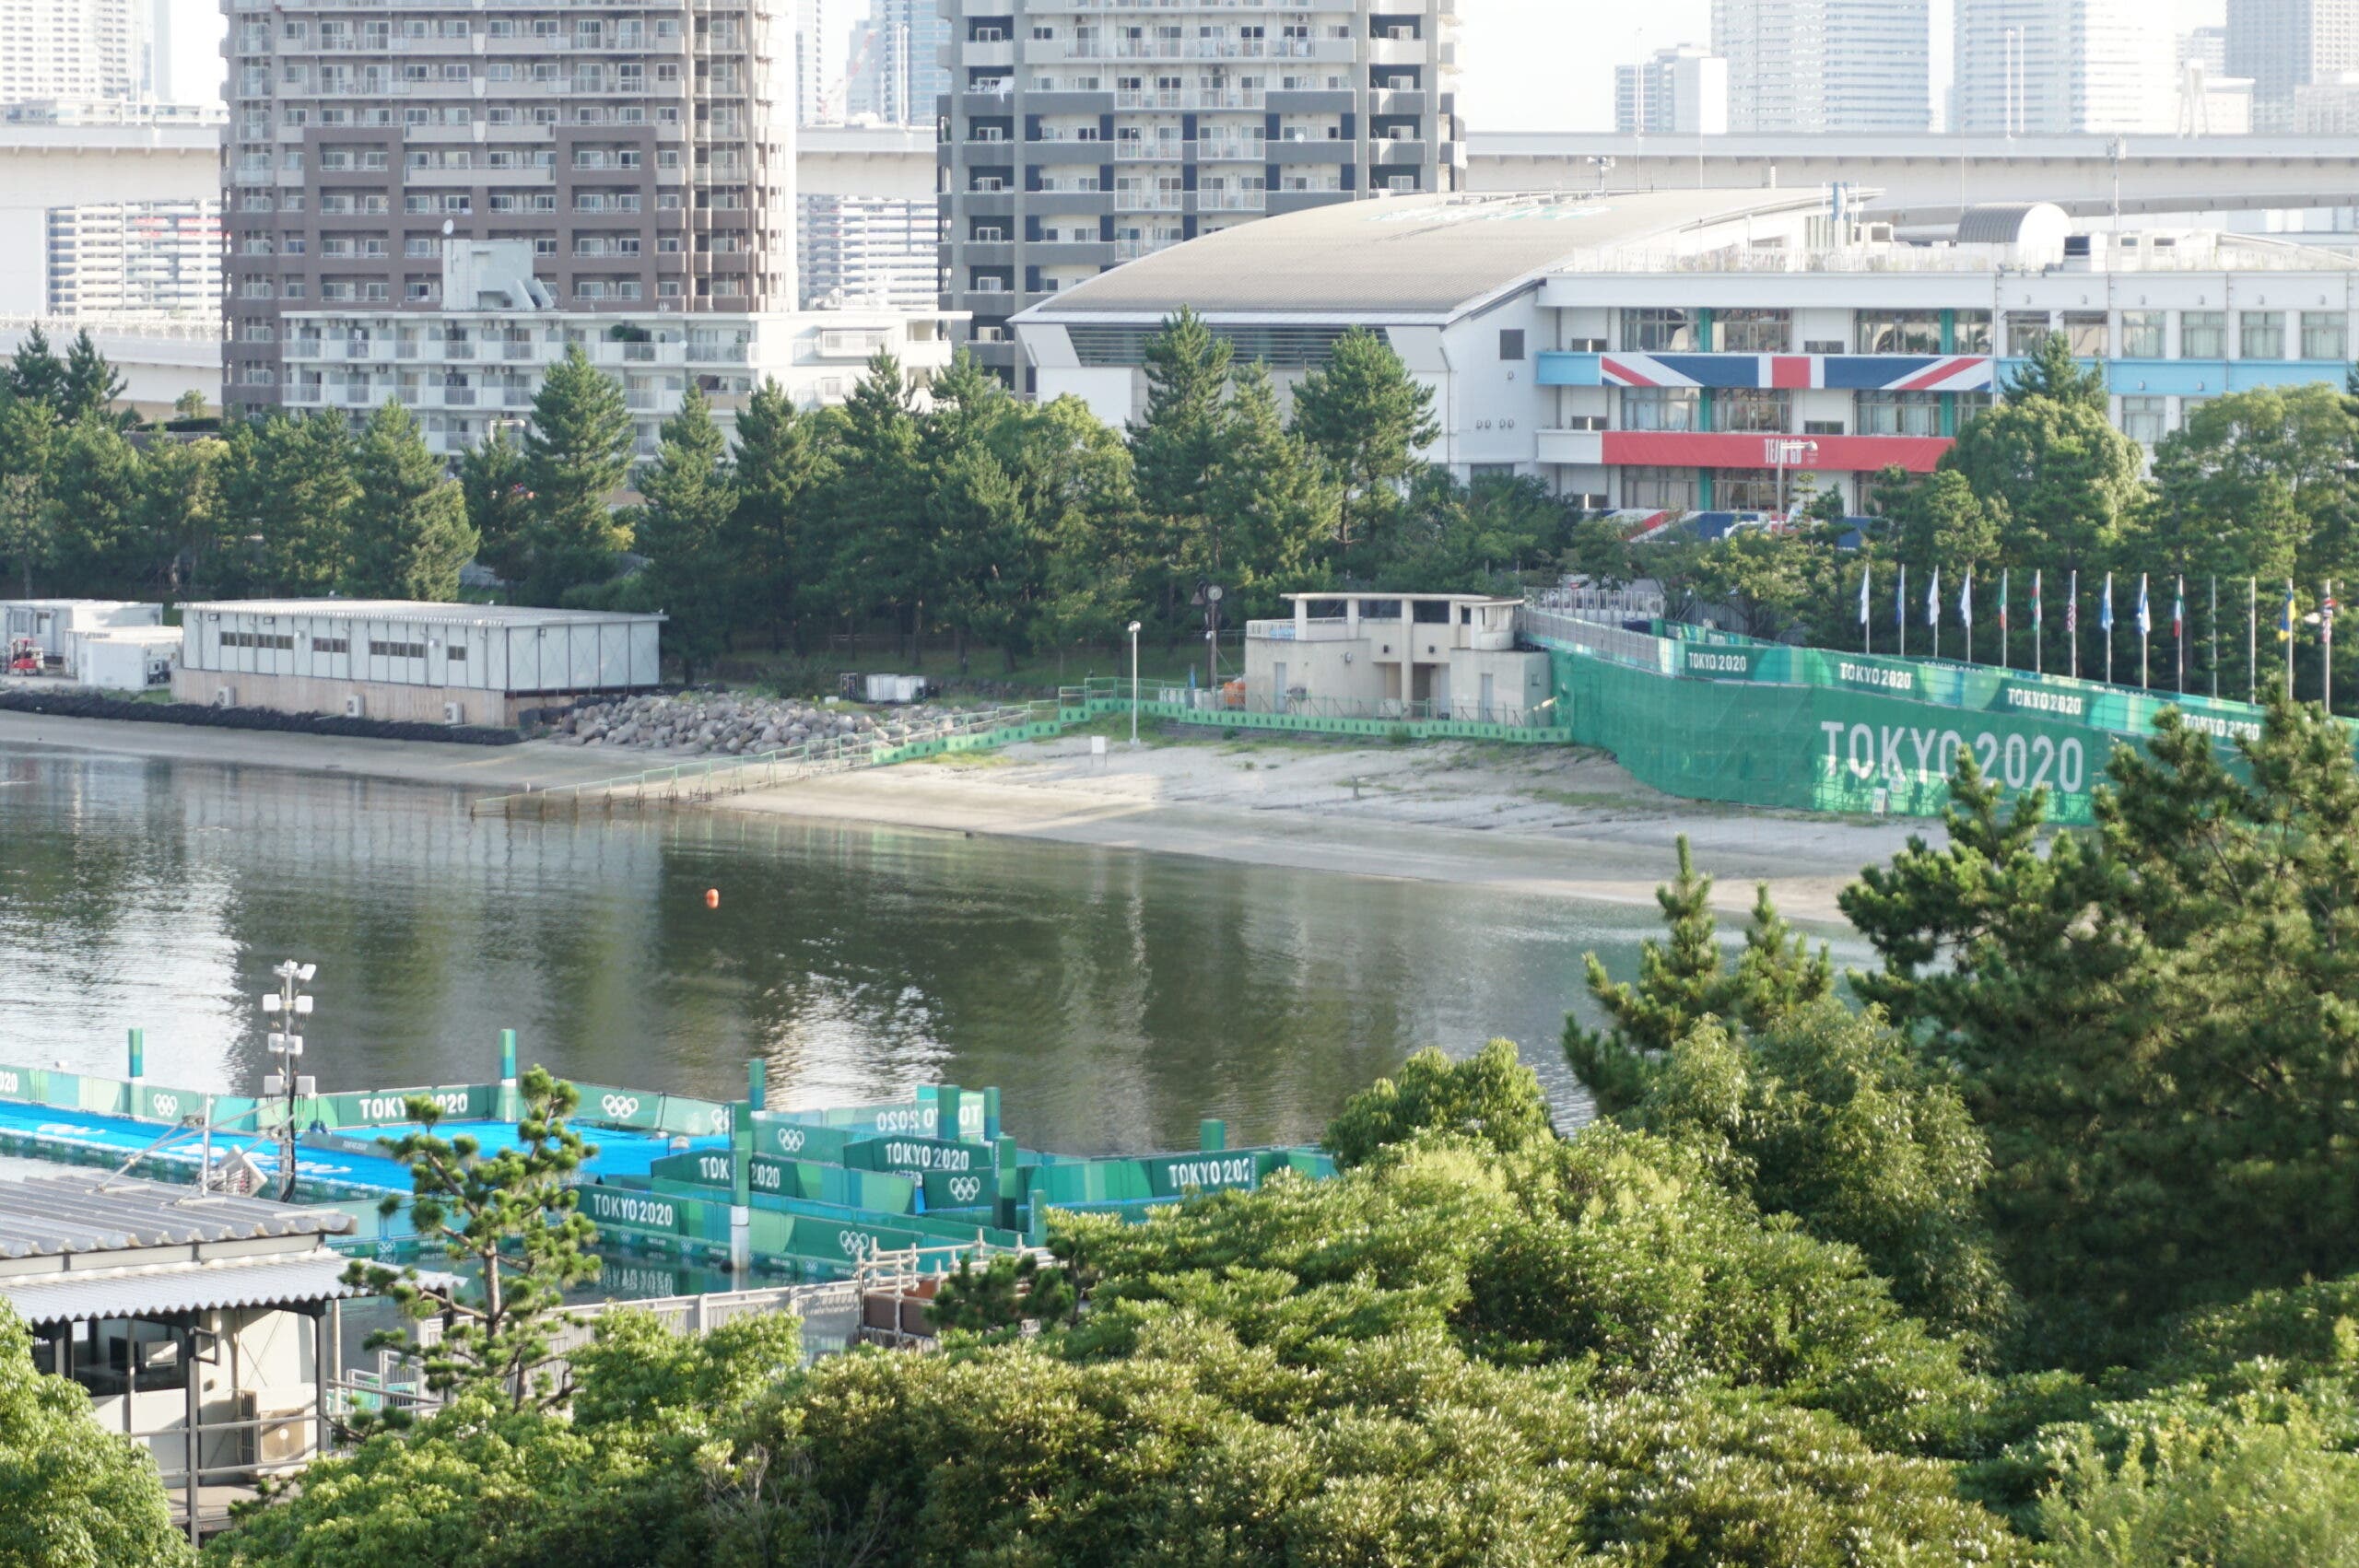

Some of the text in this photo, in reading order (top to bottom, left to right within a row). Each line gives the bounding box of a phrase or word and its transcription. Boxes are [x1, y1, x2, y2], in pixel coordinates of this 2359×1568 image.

[1687, 651, 1747, 672] TOKYO 2020
[1840, 662, 1912, 689] TOKYO 2020
[2008, 687, 2082, 714] TOKYO 2020
[1821, 721, 2083, 793] TOKYO 2020
[886, 1141, 932, 1167] TOKYO
[933, 1147, 969, 1171] 2020
[1168, 1160, 1221, 1188] TOKYO
[593, 1194, 674, 1227] TOKYO 2020
